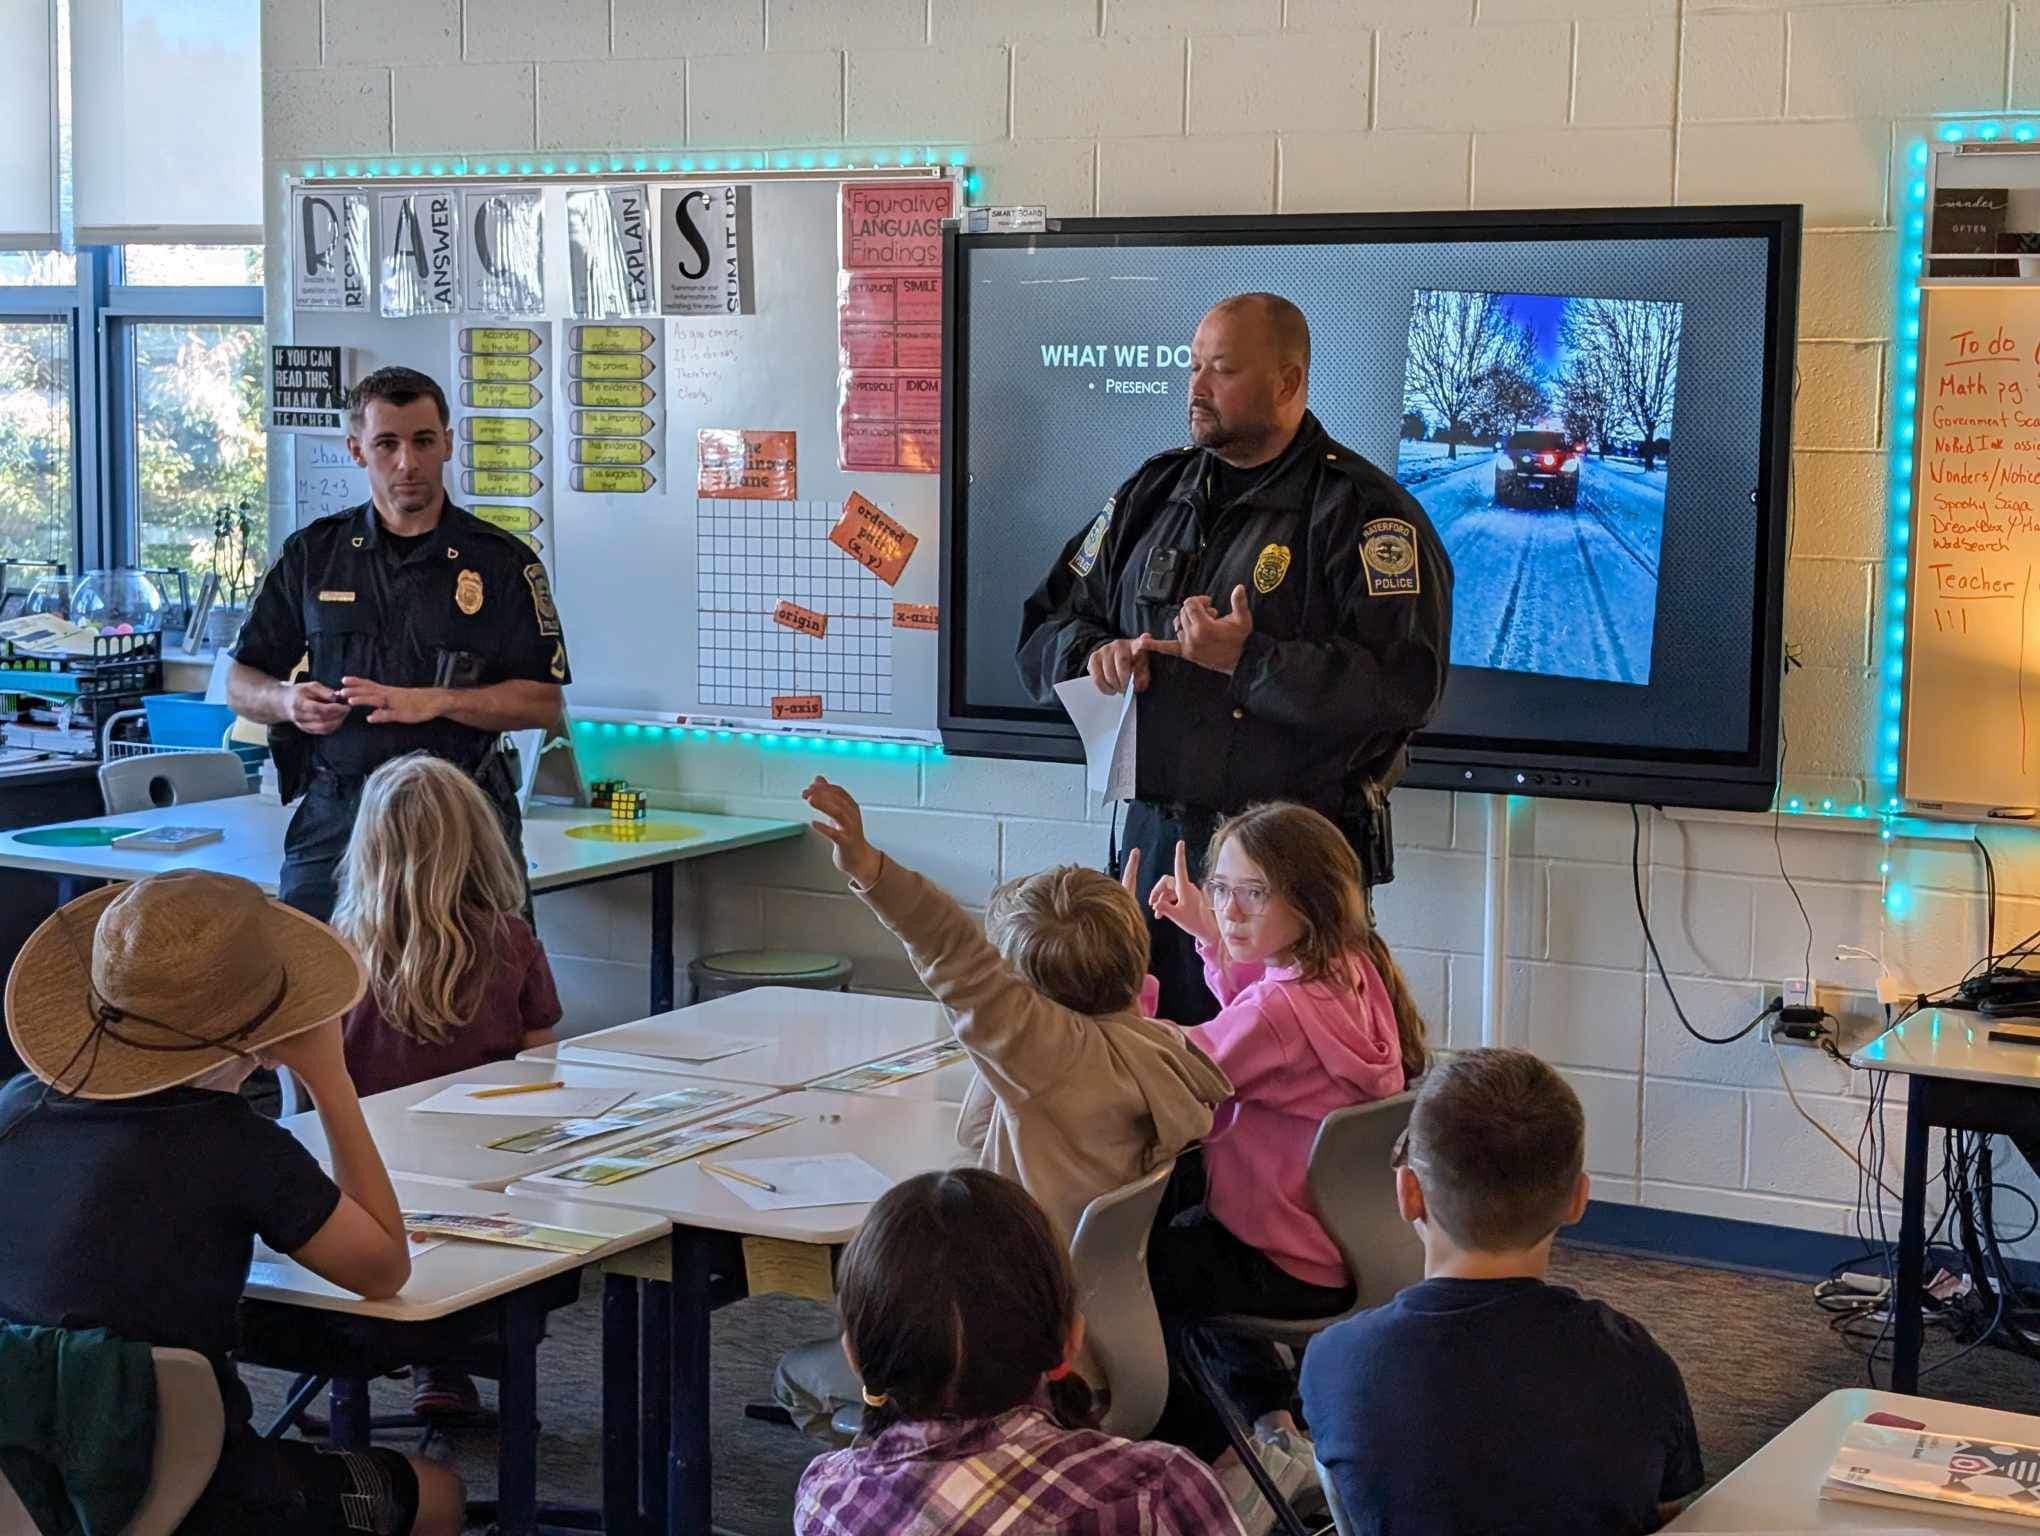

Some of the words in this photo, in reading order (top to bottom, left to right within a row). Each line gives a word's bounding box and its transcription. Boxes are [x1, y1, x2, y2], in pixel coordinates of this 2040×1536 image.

[302, 196, 339, 276] R
[393, 198, 429, 279] A
[675, 190, 711, 280] S
[726, 228, 738, 249] IT
[431, 198, 452, 305] ANSWER
[622, 198, 647, 303] EXPLAIN
[851, 238, 938, 268] Findings
[903, 280, 938, 292] SIMILE
[1950, 330, 1979, 357] To
[1988, 326, 2016, 355] do
[275, 349, 284, 367] IF
[286, 349, 308, 367] YOU
[310, 350, 332, 367] CAN
[1040, 344, 1108, 367] WHAT
[1113, 344, 1149, 367] WE
[1156, 345, 1192, 367] DO
[275, 370, 303, 388] READ
[304, 370, 332, 390] THIS,
[905, 380, 938, 392] IDIOM
[1939, 371, 1988, 397] Math
[275, 391, 318, 408] THANK
[324, 391, 333, 409] A
[276, 412, 333, 428] TEACHER
[857, 506, 906, 543] ordered
[1362, 522, 1410, 538] WATERFORD
[1375, 577, 1414, 589] POLICE
[1928, 563, 2015, 592] Teacher
[778, 608, 820, 632] origin
[775, 701, 819, 717] y-axis
